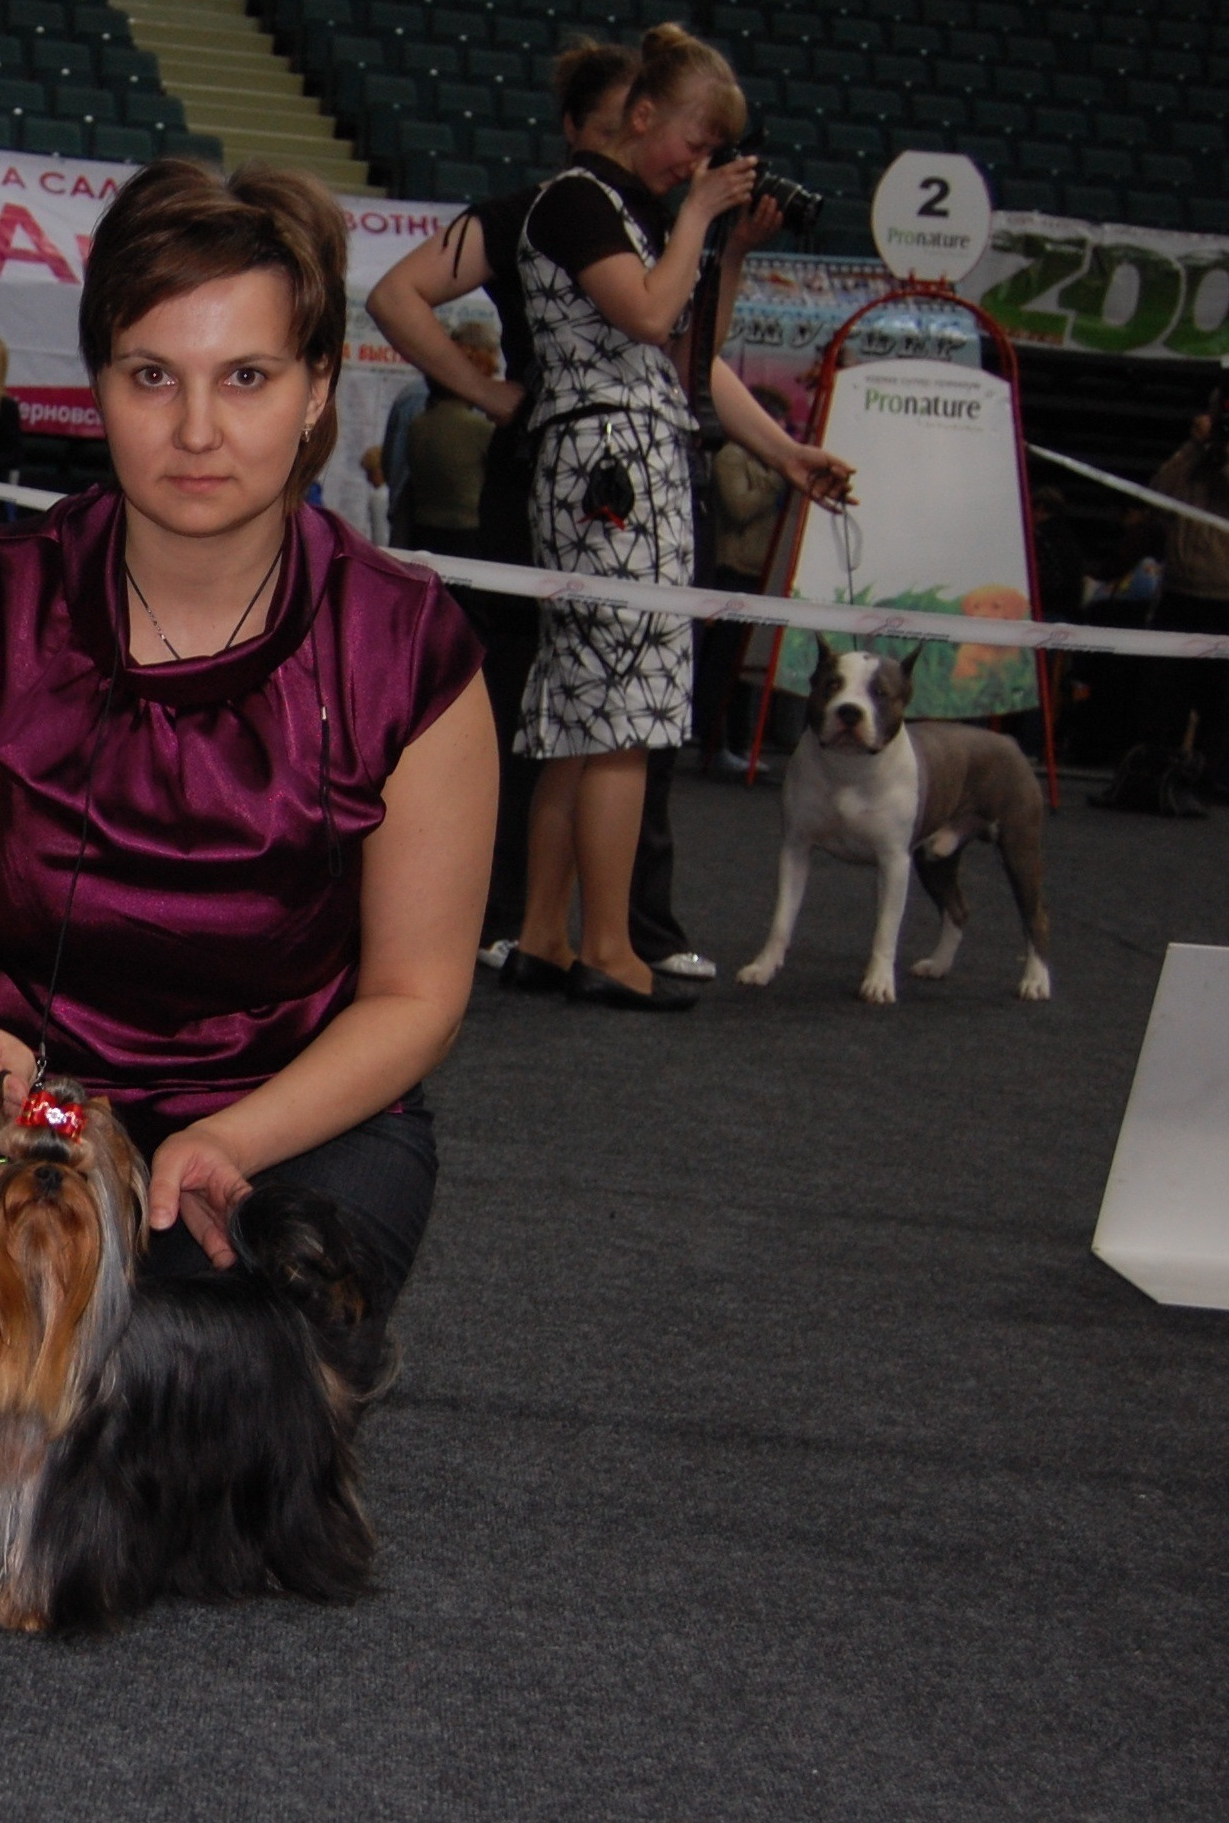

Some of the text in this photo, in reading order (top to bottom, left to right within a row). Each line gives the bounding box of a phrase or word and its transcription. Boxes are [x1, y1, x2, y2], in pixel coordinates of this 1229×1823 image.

[917, 176, 951, 218] 2
[888, 227, 972, 249] Pronature
[864, 387, 982, 421] Pronature
